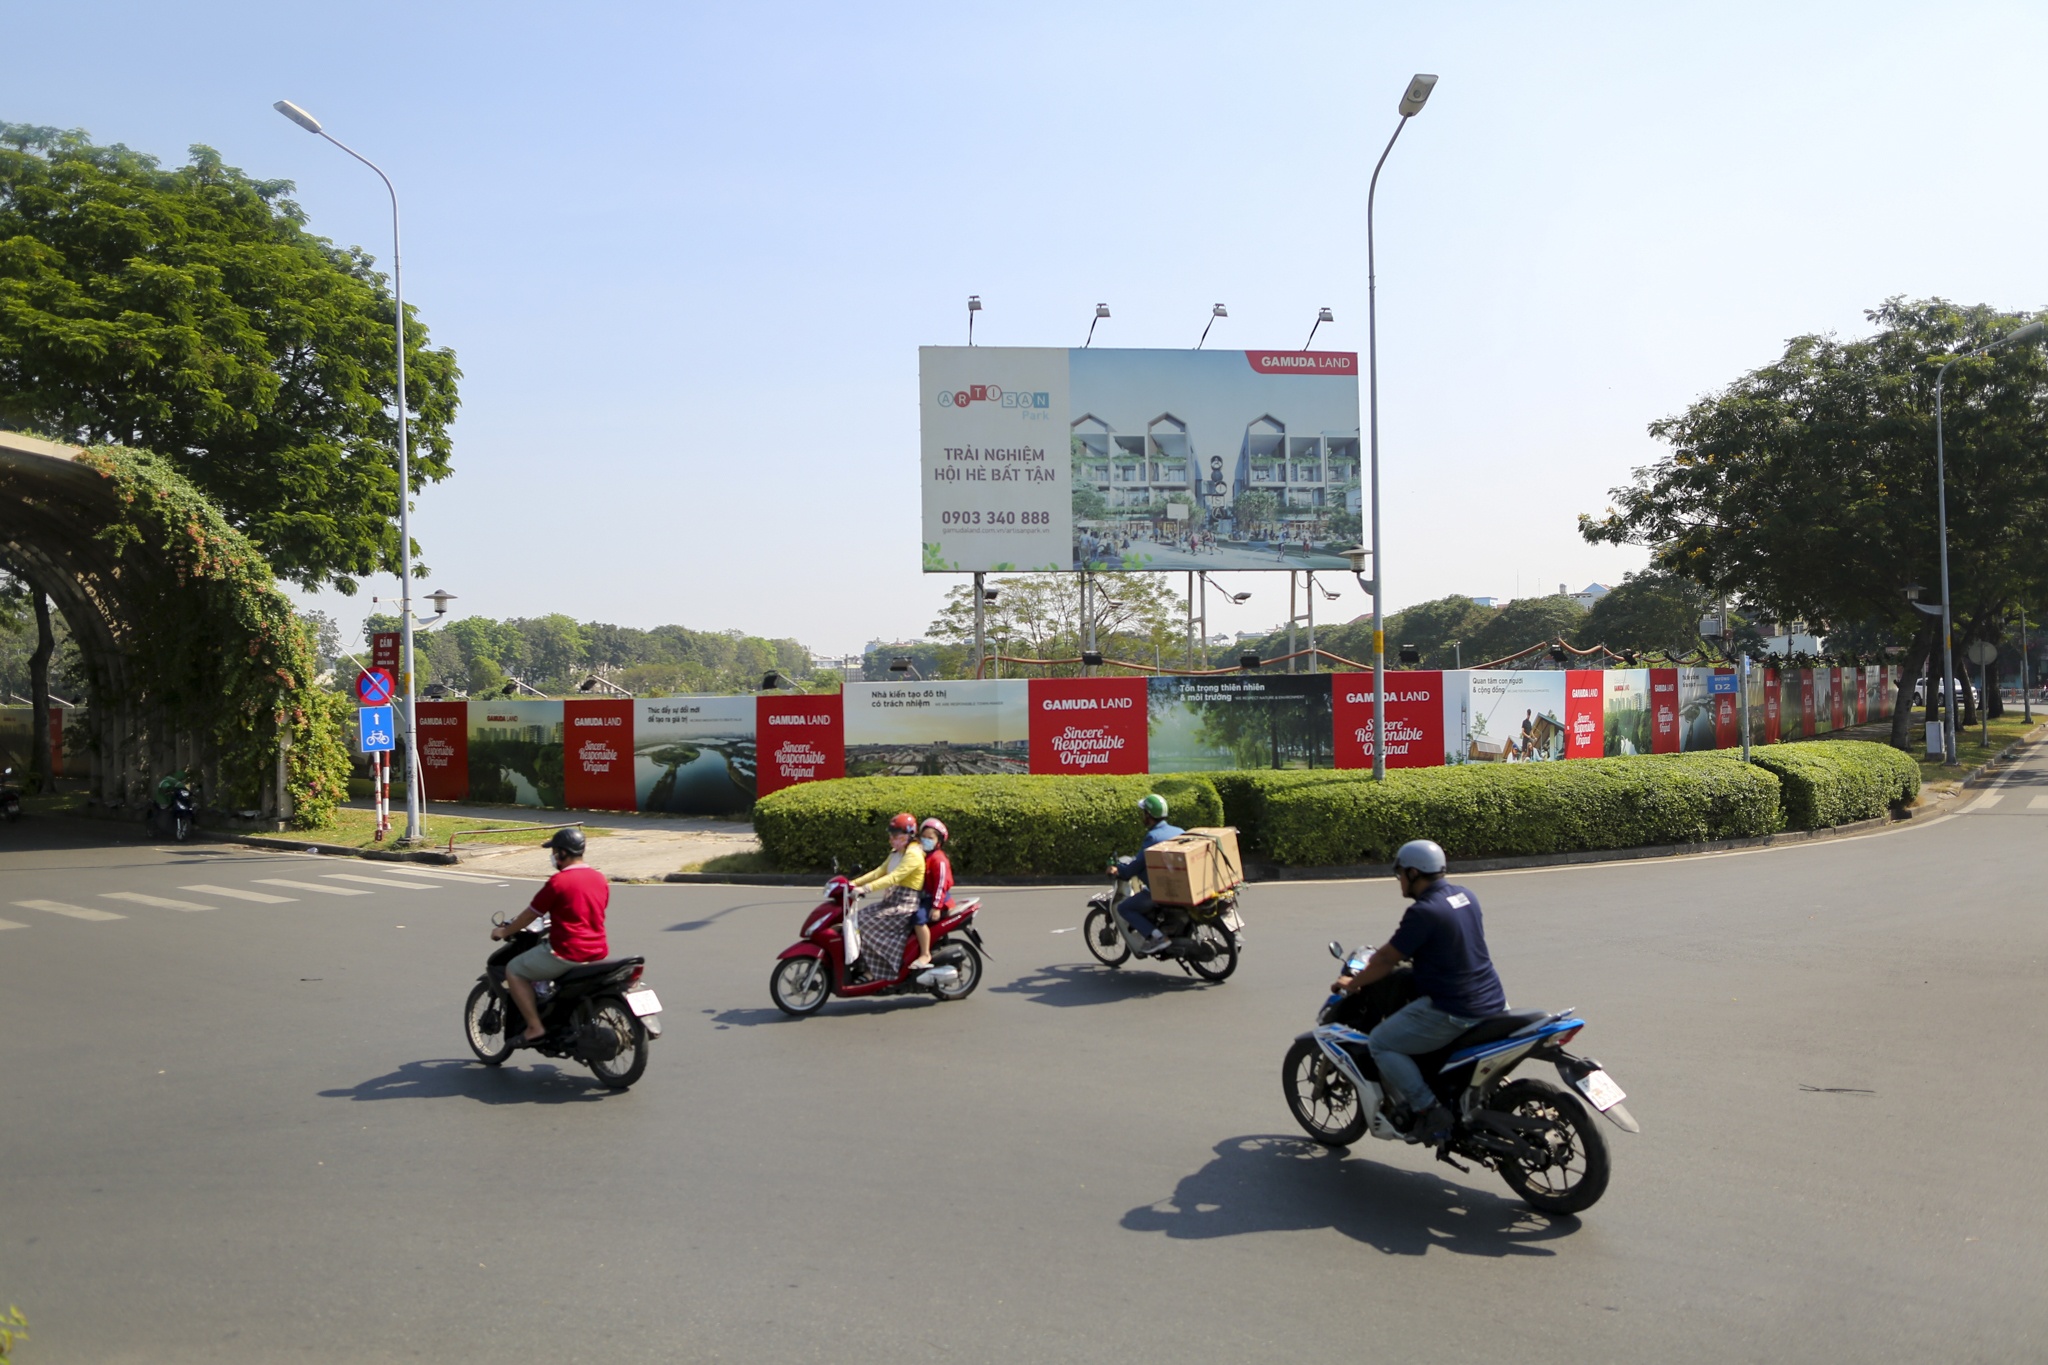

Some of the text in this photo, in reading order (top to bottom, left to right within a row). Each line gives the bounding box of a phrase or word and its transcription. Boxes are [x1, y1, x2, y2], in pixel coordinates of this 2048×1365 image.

[1261, 356, 1350, 368] GAMUDA LAND
[939, 385, 1048, 408] ARTISAN
[1022, 410, 1049, 420] Park
[944, 444, 1044, 464] TRẢI NGHIỆM
[934, 463, 1055, 484] HỘI HÈ BẤT TẬN
[942, 511, 1050, 525] 0903 340 888
[942, 527, 1050, 535] gamudaland.com.vn/artisanpark.vn
[1472, 677, 1487, 685] Quan
[889, 689, 905, 698] kiến
[908, 691, 921, 700] tạo
[936, 689, 947, 698] thị
[1180, 683, 1265, 694] Tôn trọng thiên nhiên
[1478, 687, 1491, 695] cộng
[1187, 693, 1203, 701] môi
[1205, 692, 1232, 702] trường
[1346, 691, 1430, 703] GAMDA LAND
[883, 699, 903, 707] trách
[906, 699, 930, 708] nhiệm
[1042, 698, 1133, 710] GAMUDA LAND
[648, 706, 660, 714] Thúc
[419, 717, 458, 726] GAMUDA LAND
[574, 717, 622, 727] GAMUDA LAND
[768, 714, 831, 725] GAMUDA LAND
[1365, 718, 1404, 731] Scere
[1063, 726, 1104, 739] Sincere
[1355, 727, 1423, 742] Resonsible
[782, 740, 810, 754] Sincere
[1052, 735, 1125, 754] Responsible
[774, 749, 826, 766] Responsible
[1059, 751, 1109, 768] Original
[583, 761, 609, 775] Original
[780, 764, 814, 781] Original
